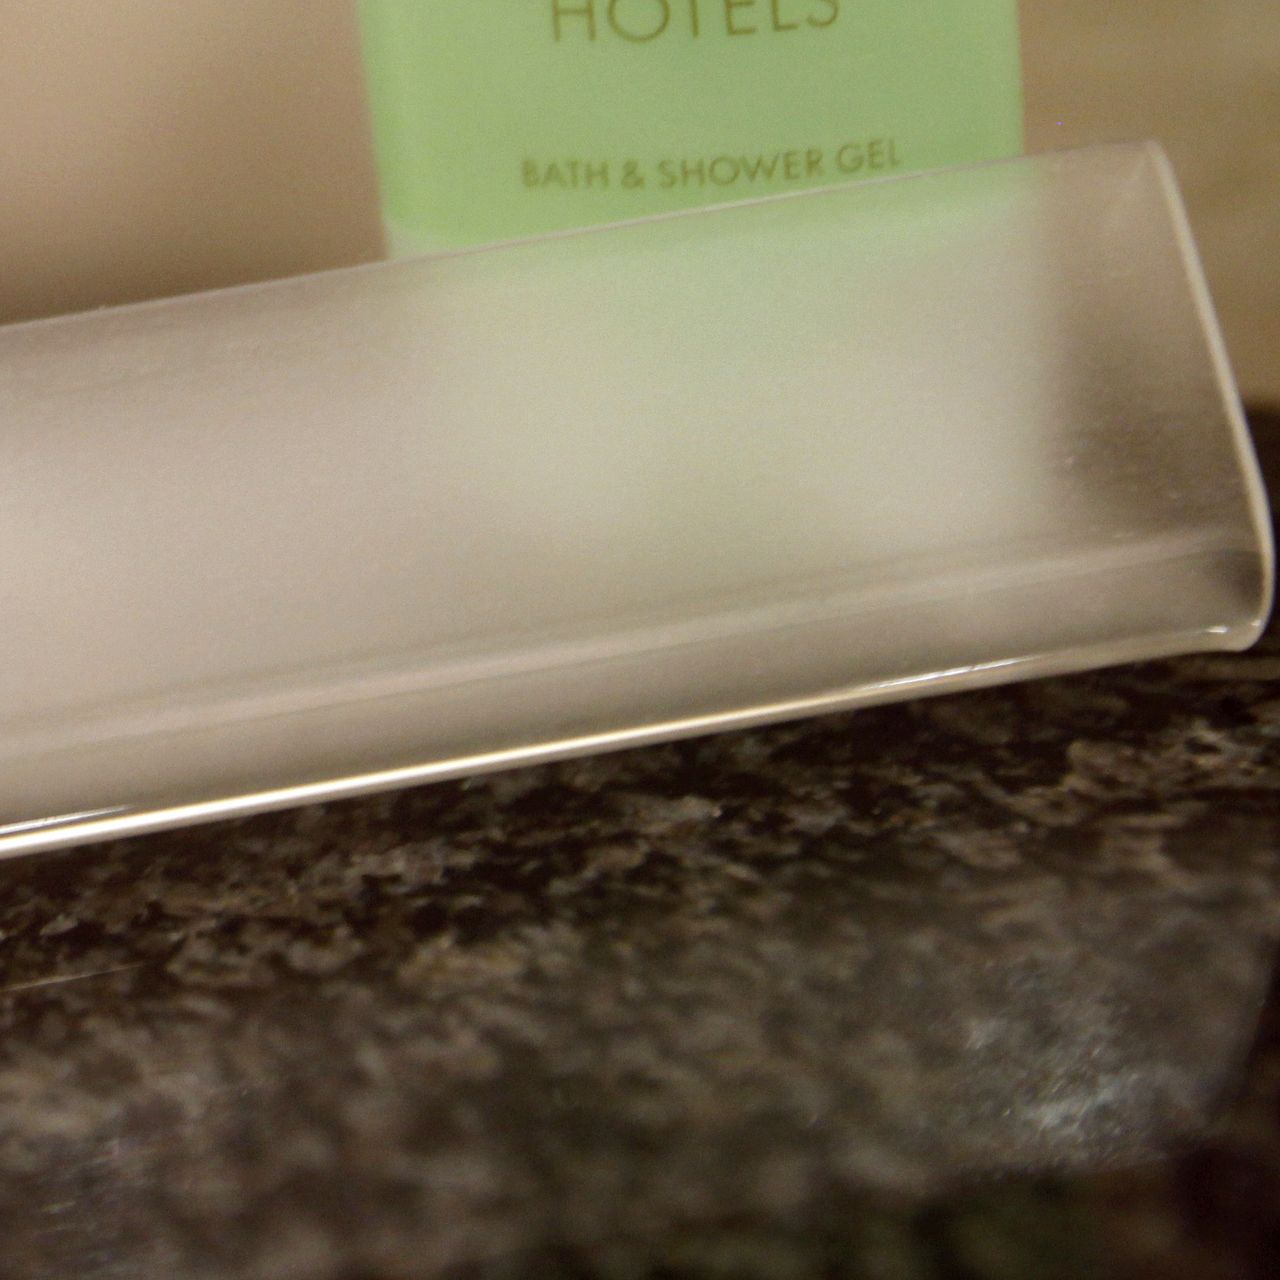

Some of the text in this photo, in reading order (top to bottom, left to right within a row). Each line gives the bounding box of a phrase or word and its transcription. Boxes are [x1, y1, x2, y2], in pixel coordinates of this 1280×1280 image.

[520, 136, 903, 190] BATH & SHOWER GEL
